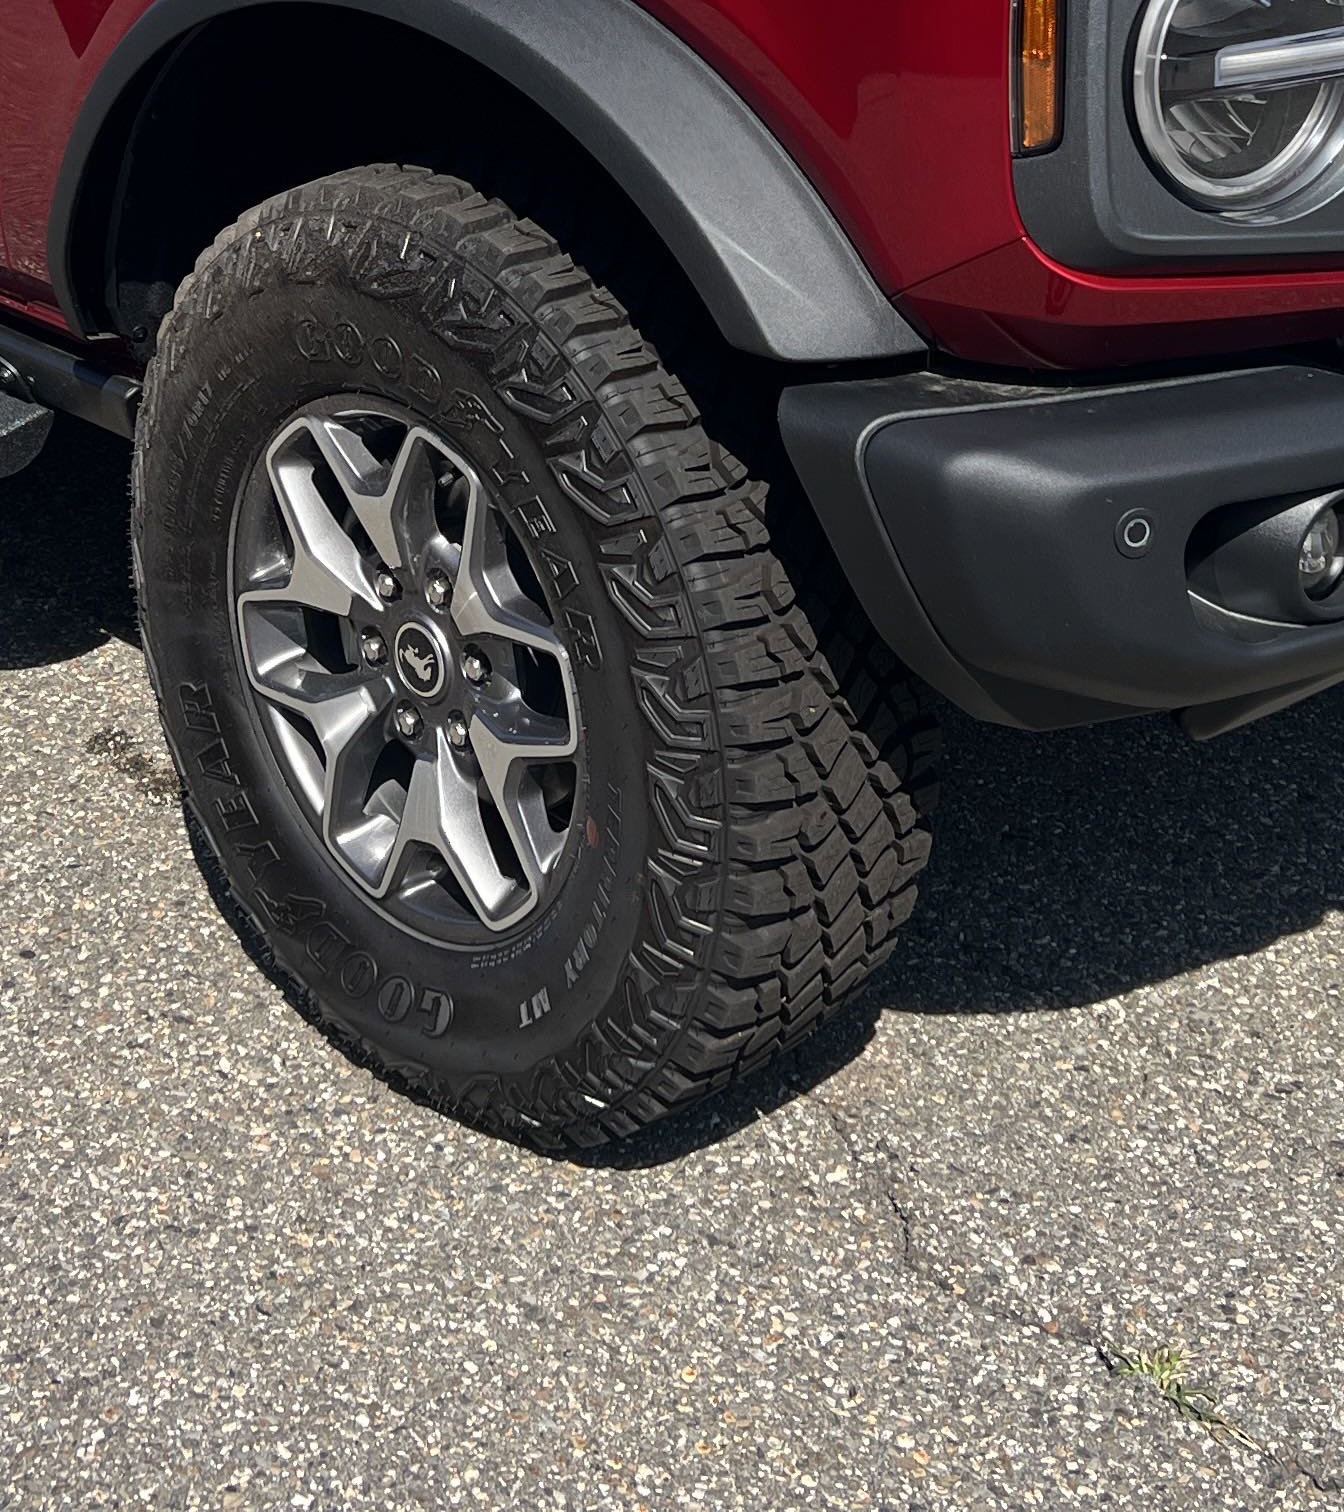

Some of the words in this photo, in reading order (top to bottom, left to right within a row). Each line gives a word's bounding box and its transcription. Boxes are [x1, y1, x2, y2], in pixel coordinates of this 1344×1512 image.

[295, 318, 604, 669] GOODYEAR
[179, 681, 454, 1037] GOODYEAR
[519, 986, 552, 1029] MT
